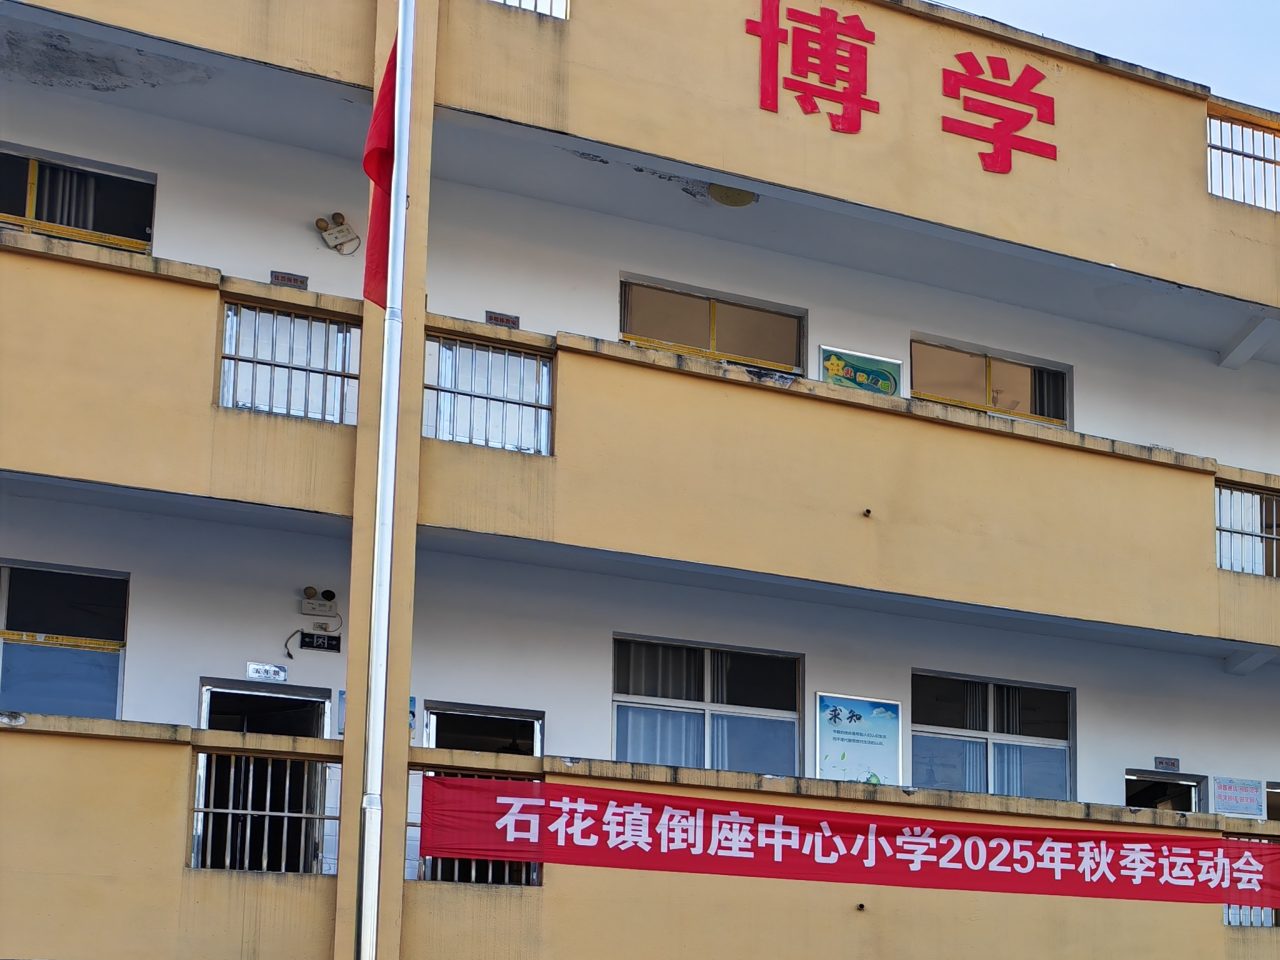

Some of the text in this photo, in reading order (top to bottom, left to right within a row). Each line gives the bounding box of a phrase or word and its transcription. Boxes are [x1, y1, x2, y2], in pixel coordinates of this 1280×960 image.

[746, 0, 1057, 174] 博学
[828, 705, 863, 724] 求知
[495, 796, 1265, 891] 石花镇倒座中心小学2025年秋季运动会
